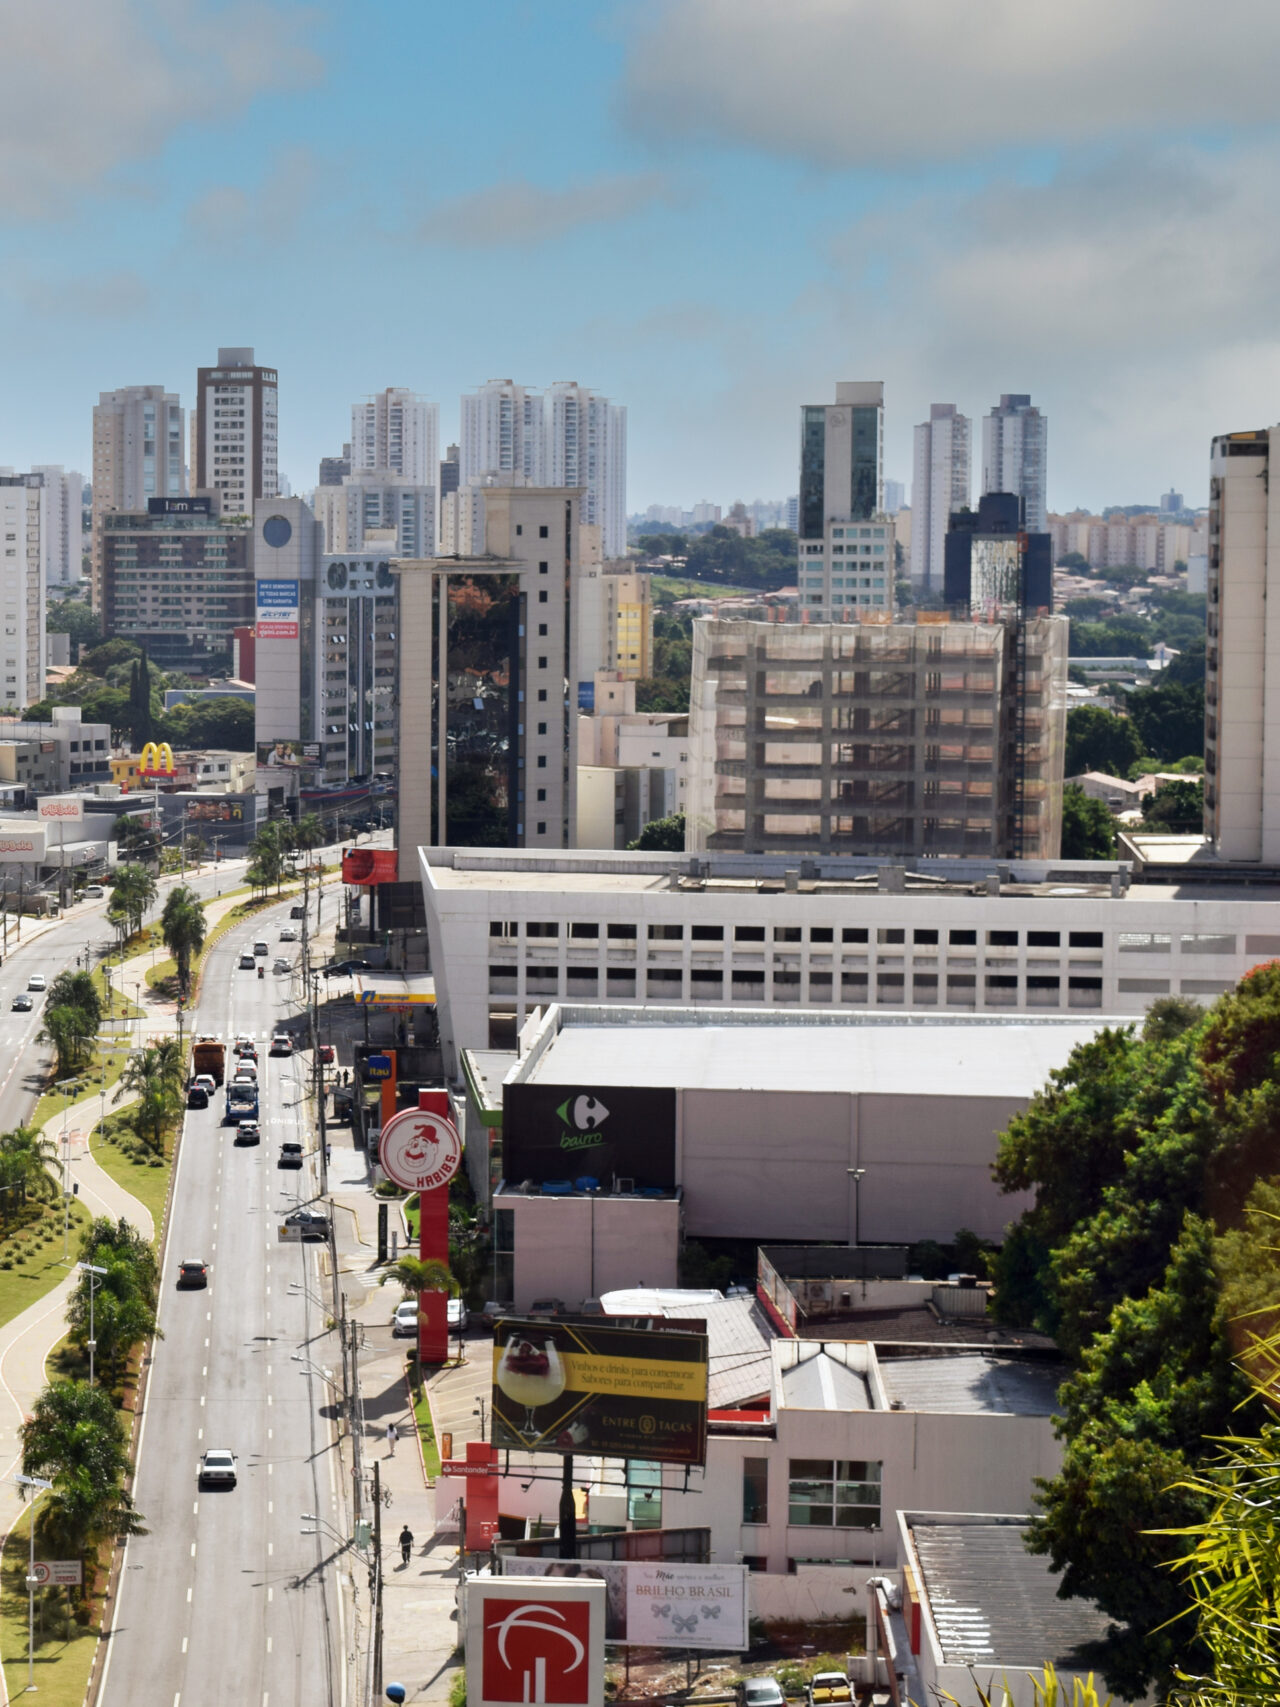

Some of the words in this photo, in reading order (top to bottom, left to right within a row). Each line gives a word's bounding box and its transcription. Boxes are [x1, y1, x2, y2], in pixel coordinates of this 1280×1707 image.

[560, 1130, 602, 1149] bairro
[631, 1367, 649, 1378] para
[581, 1374, 613, 1385] Sabores
[614, 1377, 632, 1389] para
[601, 1415, 635, 1428] ENTRE
[451, 1465, 488, 1475] Santander
[635, 1584, 686, 1597] BRILHO
[688, 1585, 734, 1598] BRASIL
